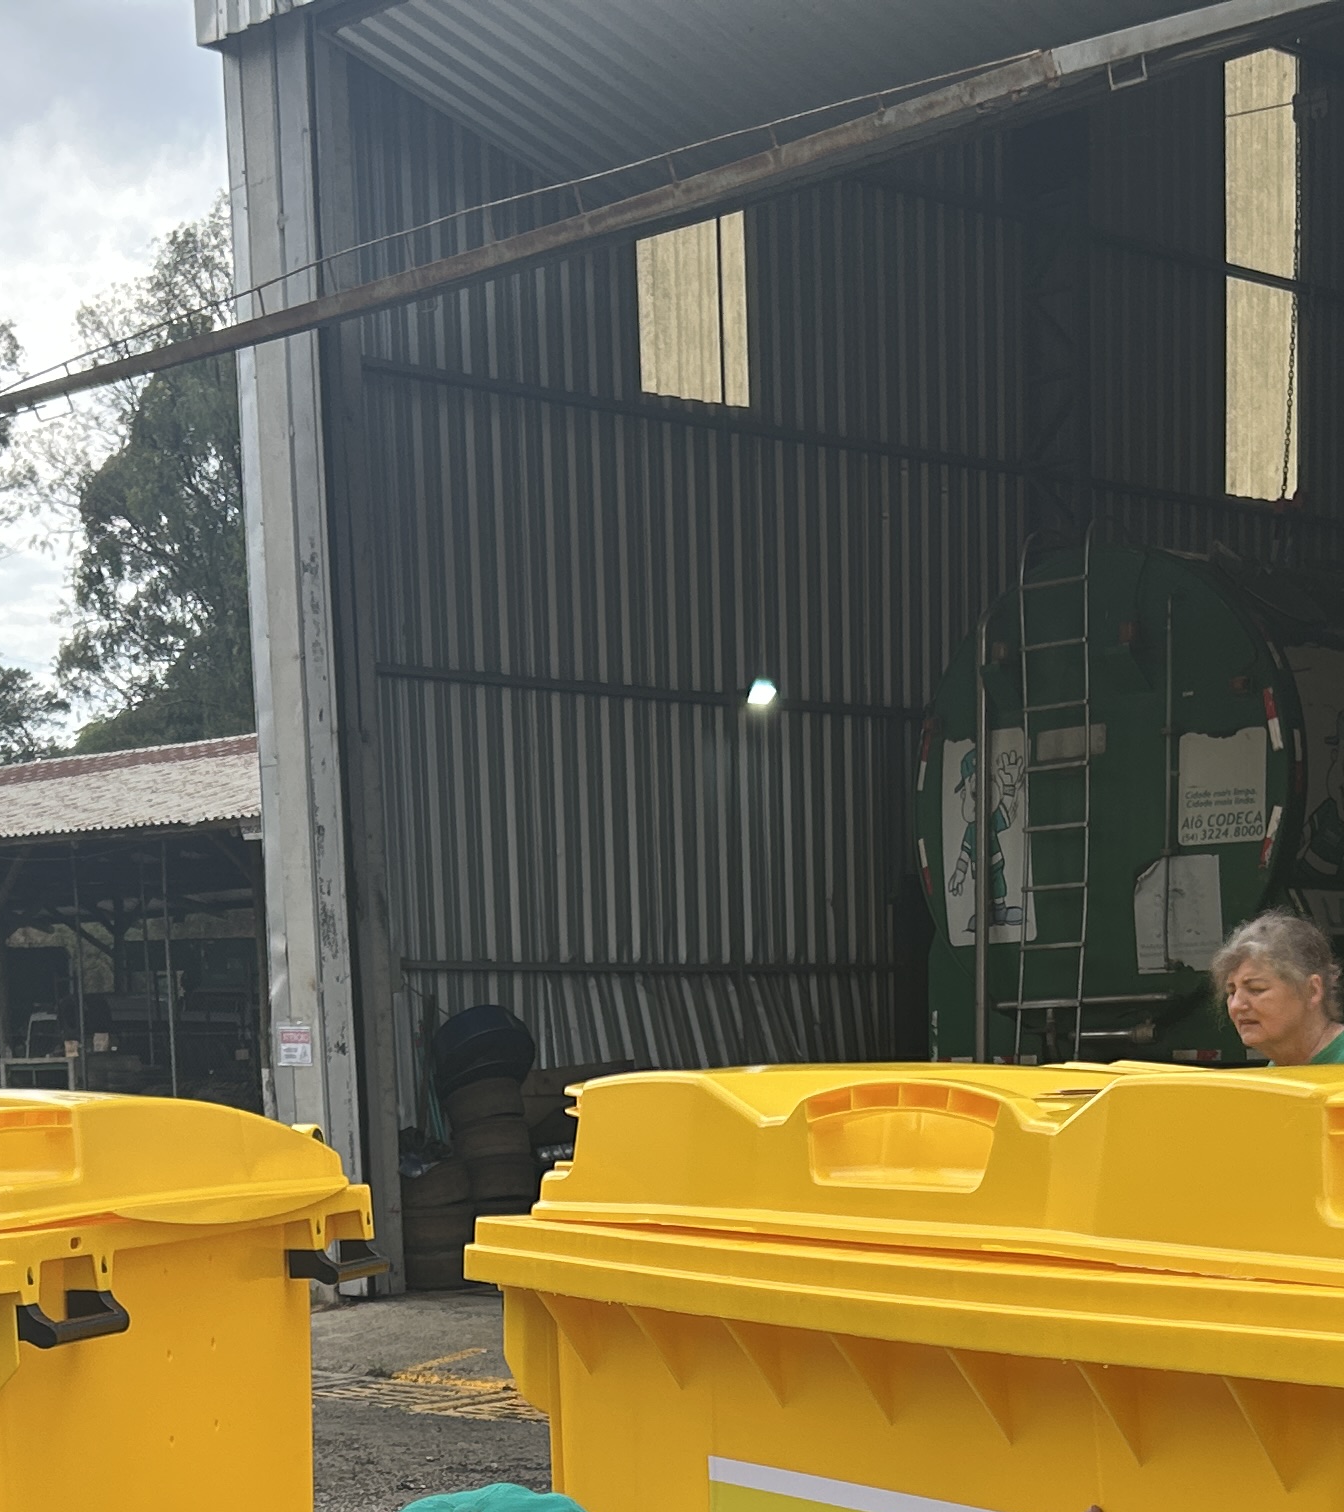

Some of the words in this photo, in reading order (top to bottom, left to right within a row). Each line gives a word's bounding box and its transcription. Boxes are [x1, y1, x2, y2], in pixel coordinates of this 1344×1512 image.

[1181, 815, 1203, 831] Alô
[1207, 810, 1263, 828] CODECA
[1182, 833, 1198, 844] (54)
[1200, 824, 1263, 840] 3224.8000
